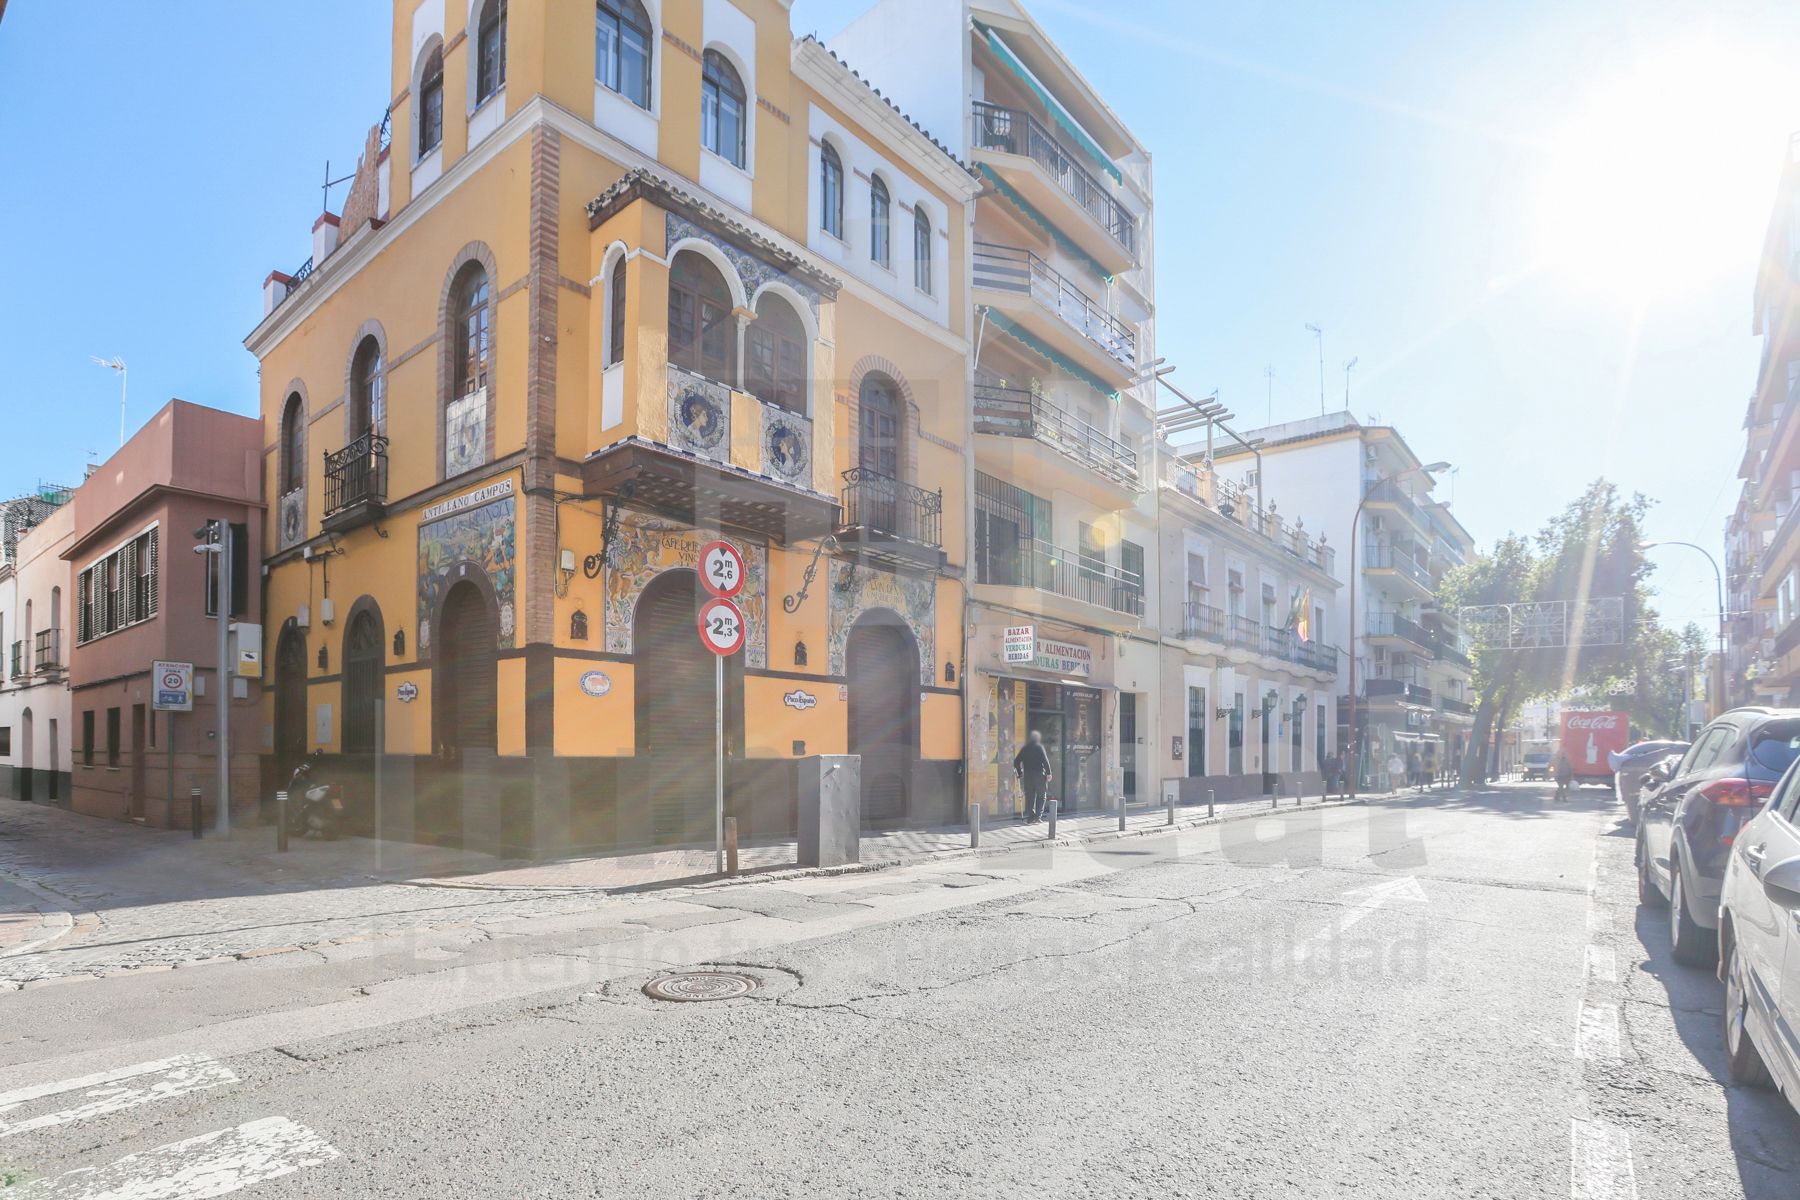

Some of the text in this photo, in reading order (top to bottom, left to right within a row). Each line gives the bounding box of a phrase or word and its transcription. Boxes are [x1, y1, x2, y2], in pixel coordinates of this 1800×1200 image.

[423, 495, 469, 521] ANTILLANO
[474, 480, 512, 503] CAMPOS
[1007, 627, 1030, 636] BAZAR
[1005, 643, 1032, 652] VERDURAS
[1045, 643, 1091, 660] ALIMENTACION
[1007, 652, 1029, 661] BEBIDAS
